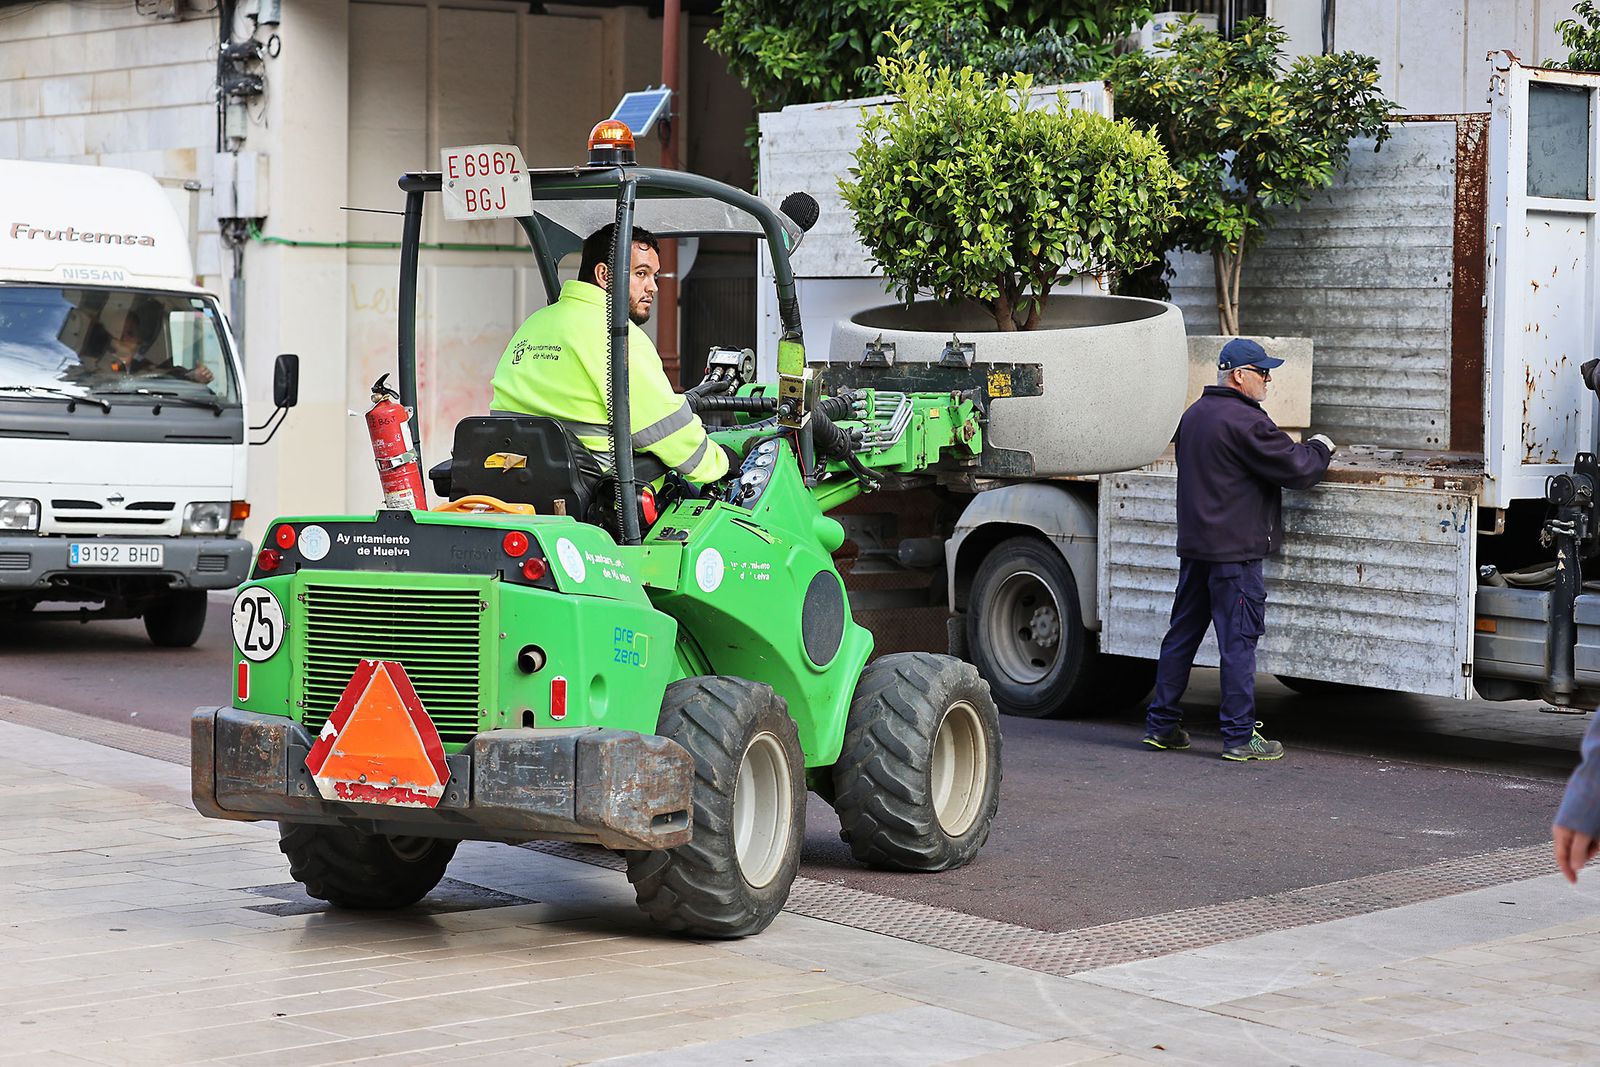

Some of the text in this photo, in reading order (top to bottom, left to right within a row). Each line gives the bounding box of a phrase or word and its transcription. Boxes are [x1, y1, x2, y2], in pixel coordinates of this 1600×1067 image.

[466, 186, 506, 212] BGJ
[10, 222, 155, 247] Frutemsa
[62, 267, 124, 281] NISSAN
[82, 547, 120, 562] 9192
[129, 547, 160, 563] BHD
[357, 546, 410, 557] de Huelva
[240, 596, 275, 652] 25
[614, 627, 634, 645] pre
[614, 648, 640, 666] zero
